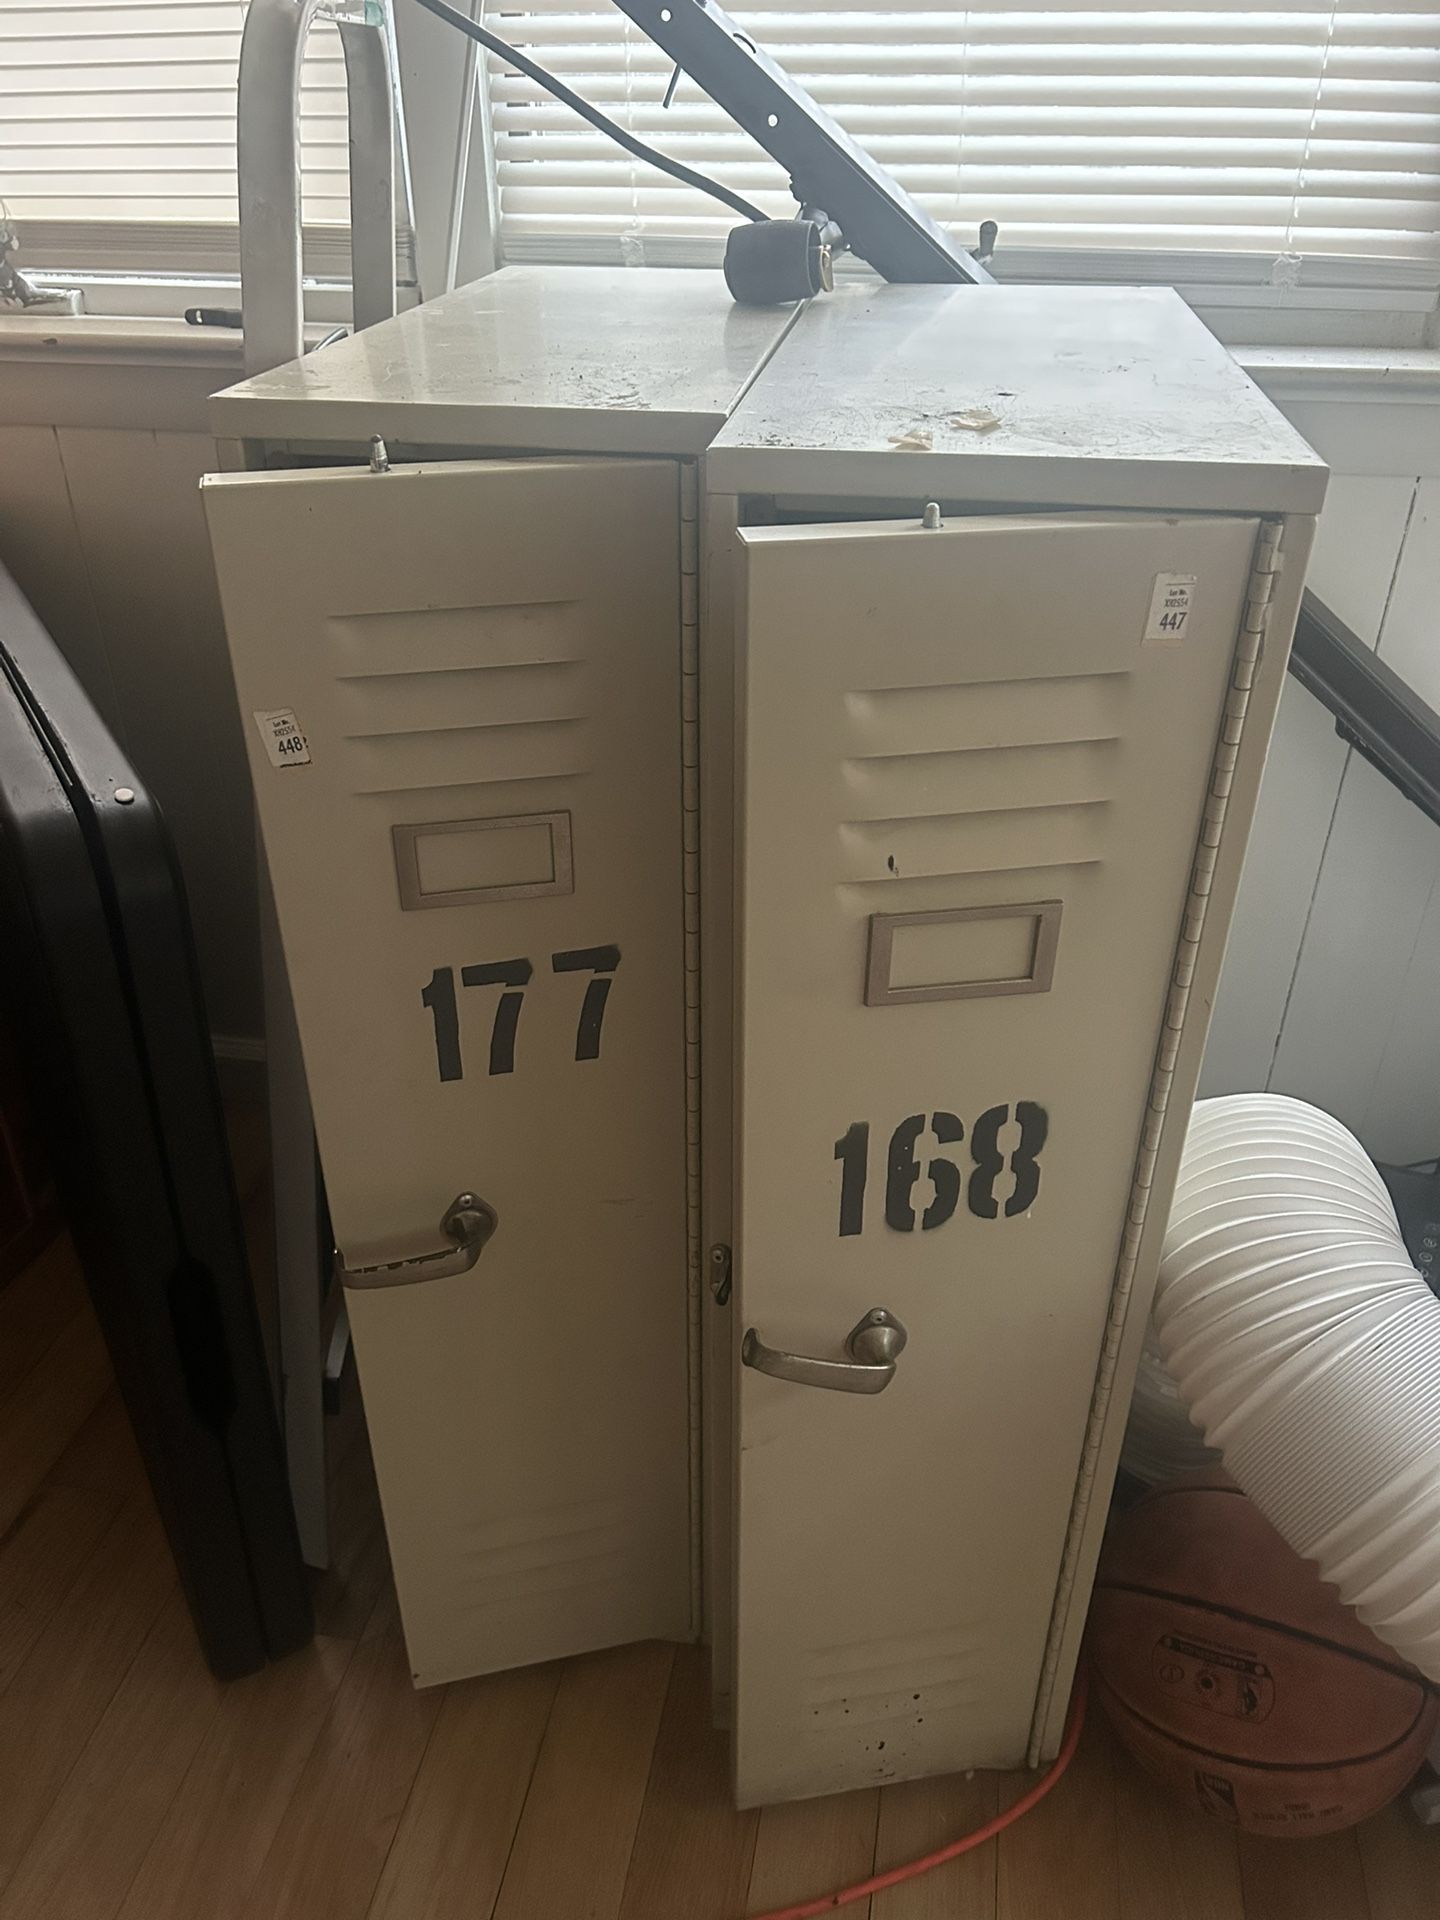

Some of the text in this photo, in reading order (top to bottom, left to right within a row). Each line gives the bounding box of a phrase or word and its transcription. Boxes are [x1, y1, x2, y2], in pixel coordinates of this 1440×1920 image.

[1159, 612, 1188, 631] 447
[278, 736, 303, 755] 448
[421, 944, 622, 1082] 177
[834, 1101, 1049, 1237] 168
